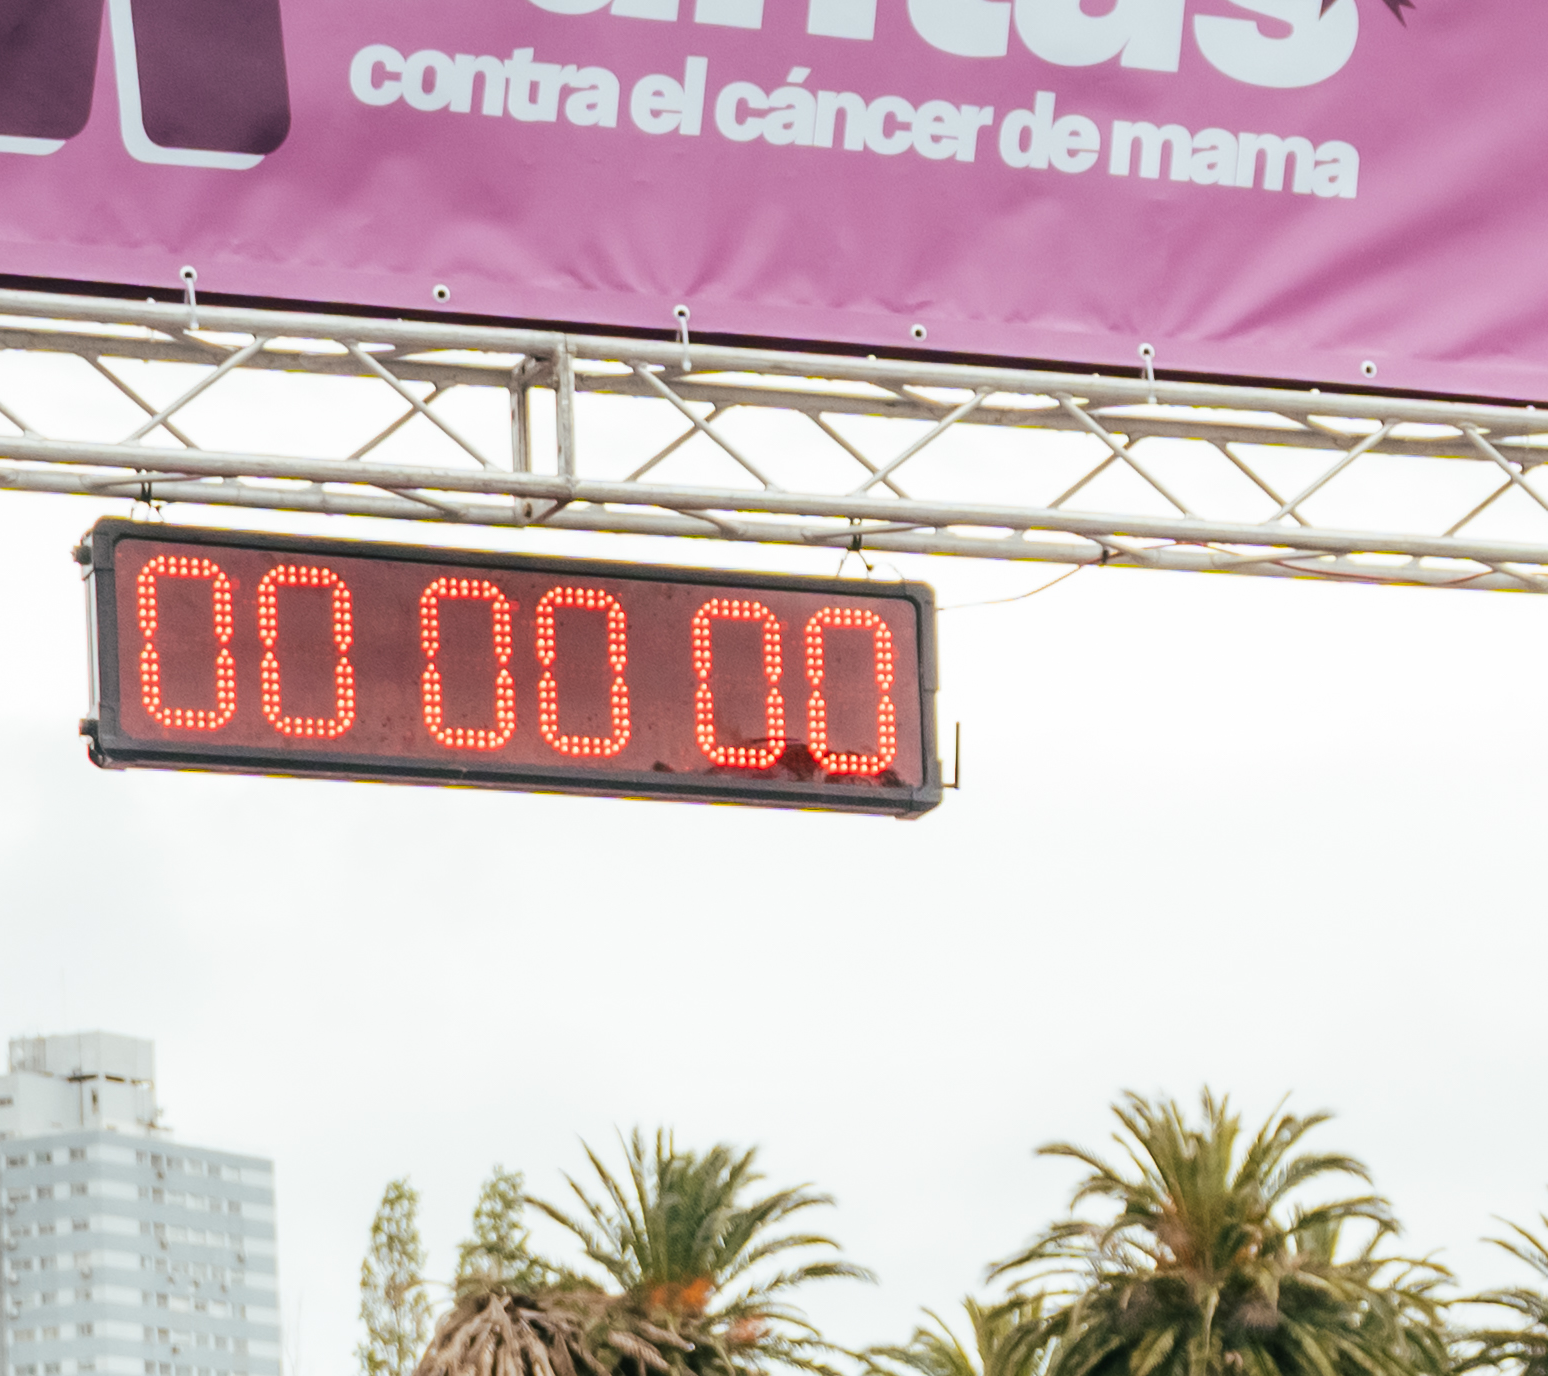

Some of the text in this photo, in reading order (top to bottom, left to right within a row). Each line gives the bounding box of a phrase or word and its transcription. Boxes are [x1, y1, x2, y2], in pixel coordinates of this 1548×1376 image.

[350, 44, 619, 127] contra
[630, 56, 708, 135] el
[715, 67, 994, 161] cáncer
[998, 91, 1100, 173] de
[1110, 119, 1359, 198] mama
